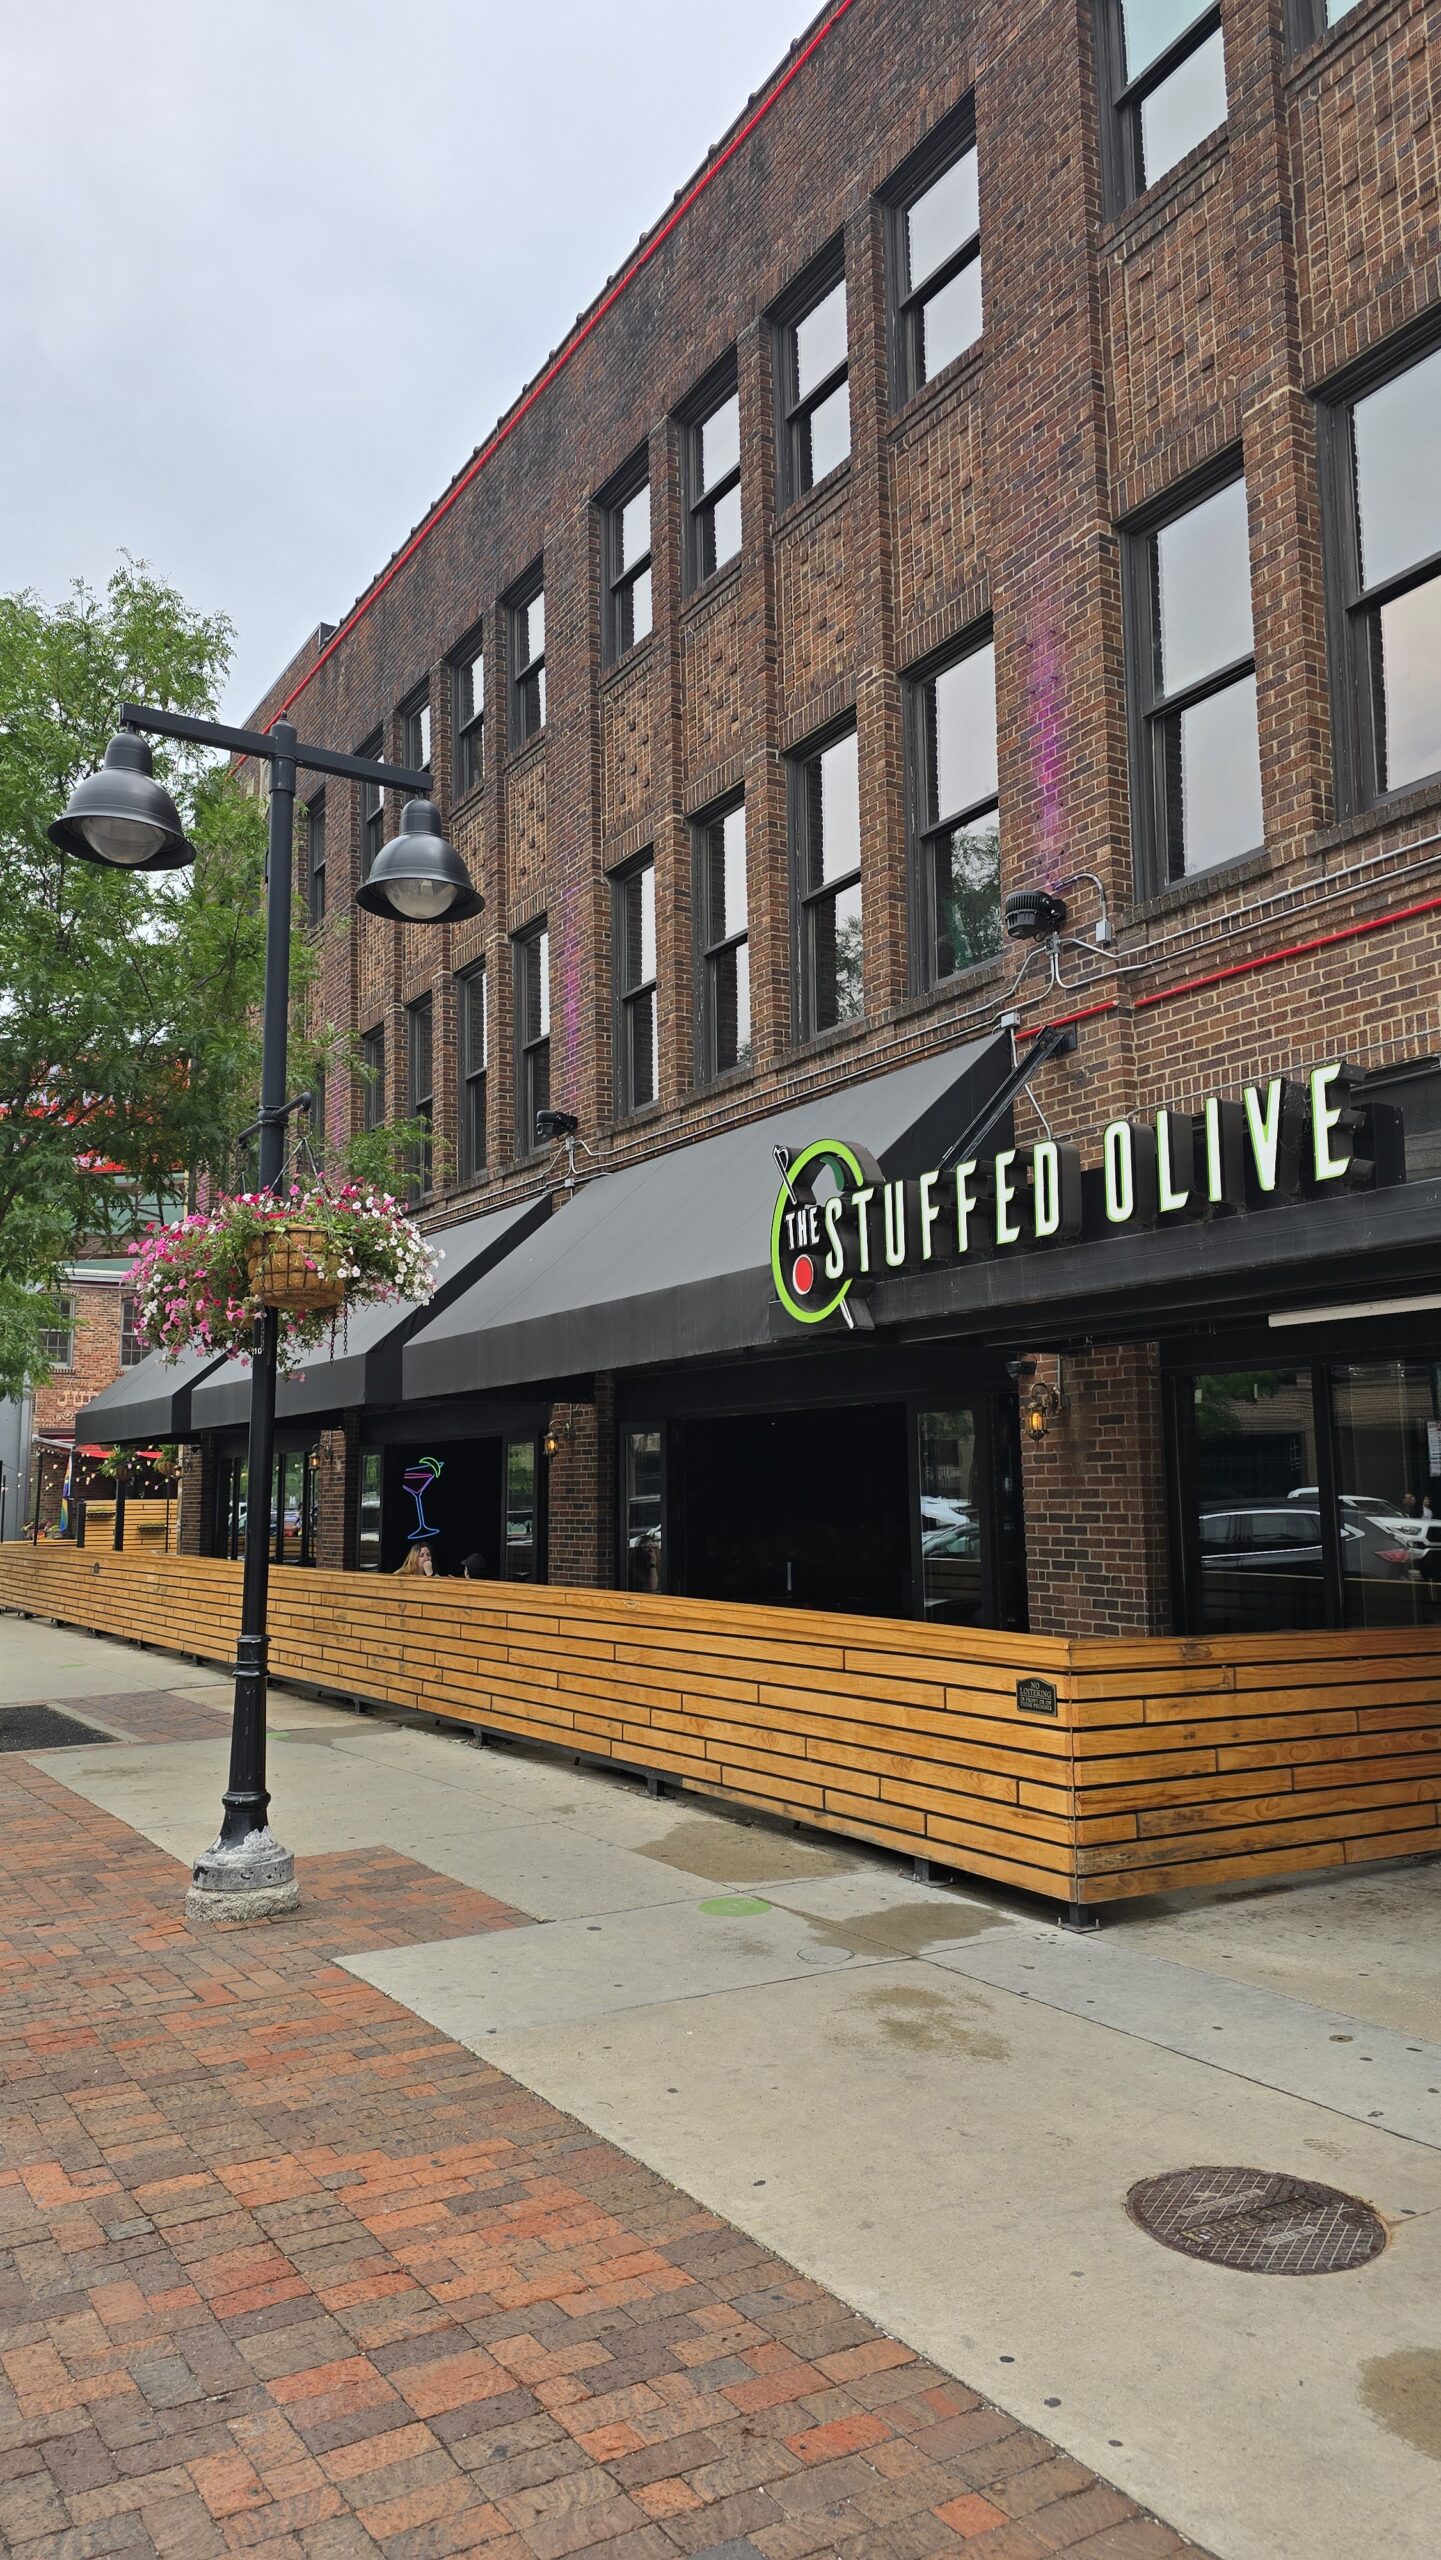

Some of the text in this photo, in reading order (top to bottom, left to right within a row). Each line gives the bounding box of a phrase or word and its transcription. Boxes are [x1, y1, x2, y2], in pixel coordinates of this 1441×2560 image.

[825, 1061, 1352, 1280] STUFFED OLIVE
[785, 1205, 820, 1250] THE
[1020, 1687, 1051, 1698] LOITERING
[1030, 1681, 1040, 1690] NO
